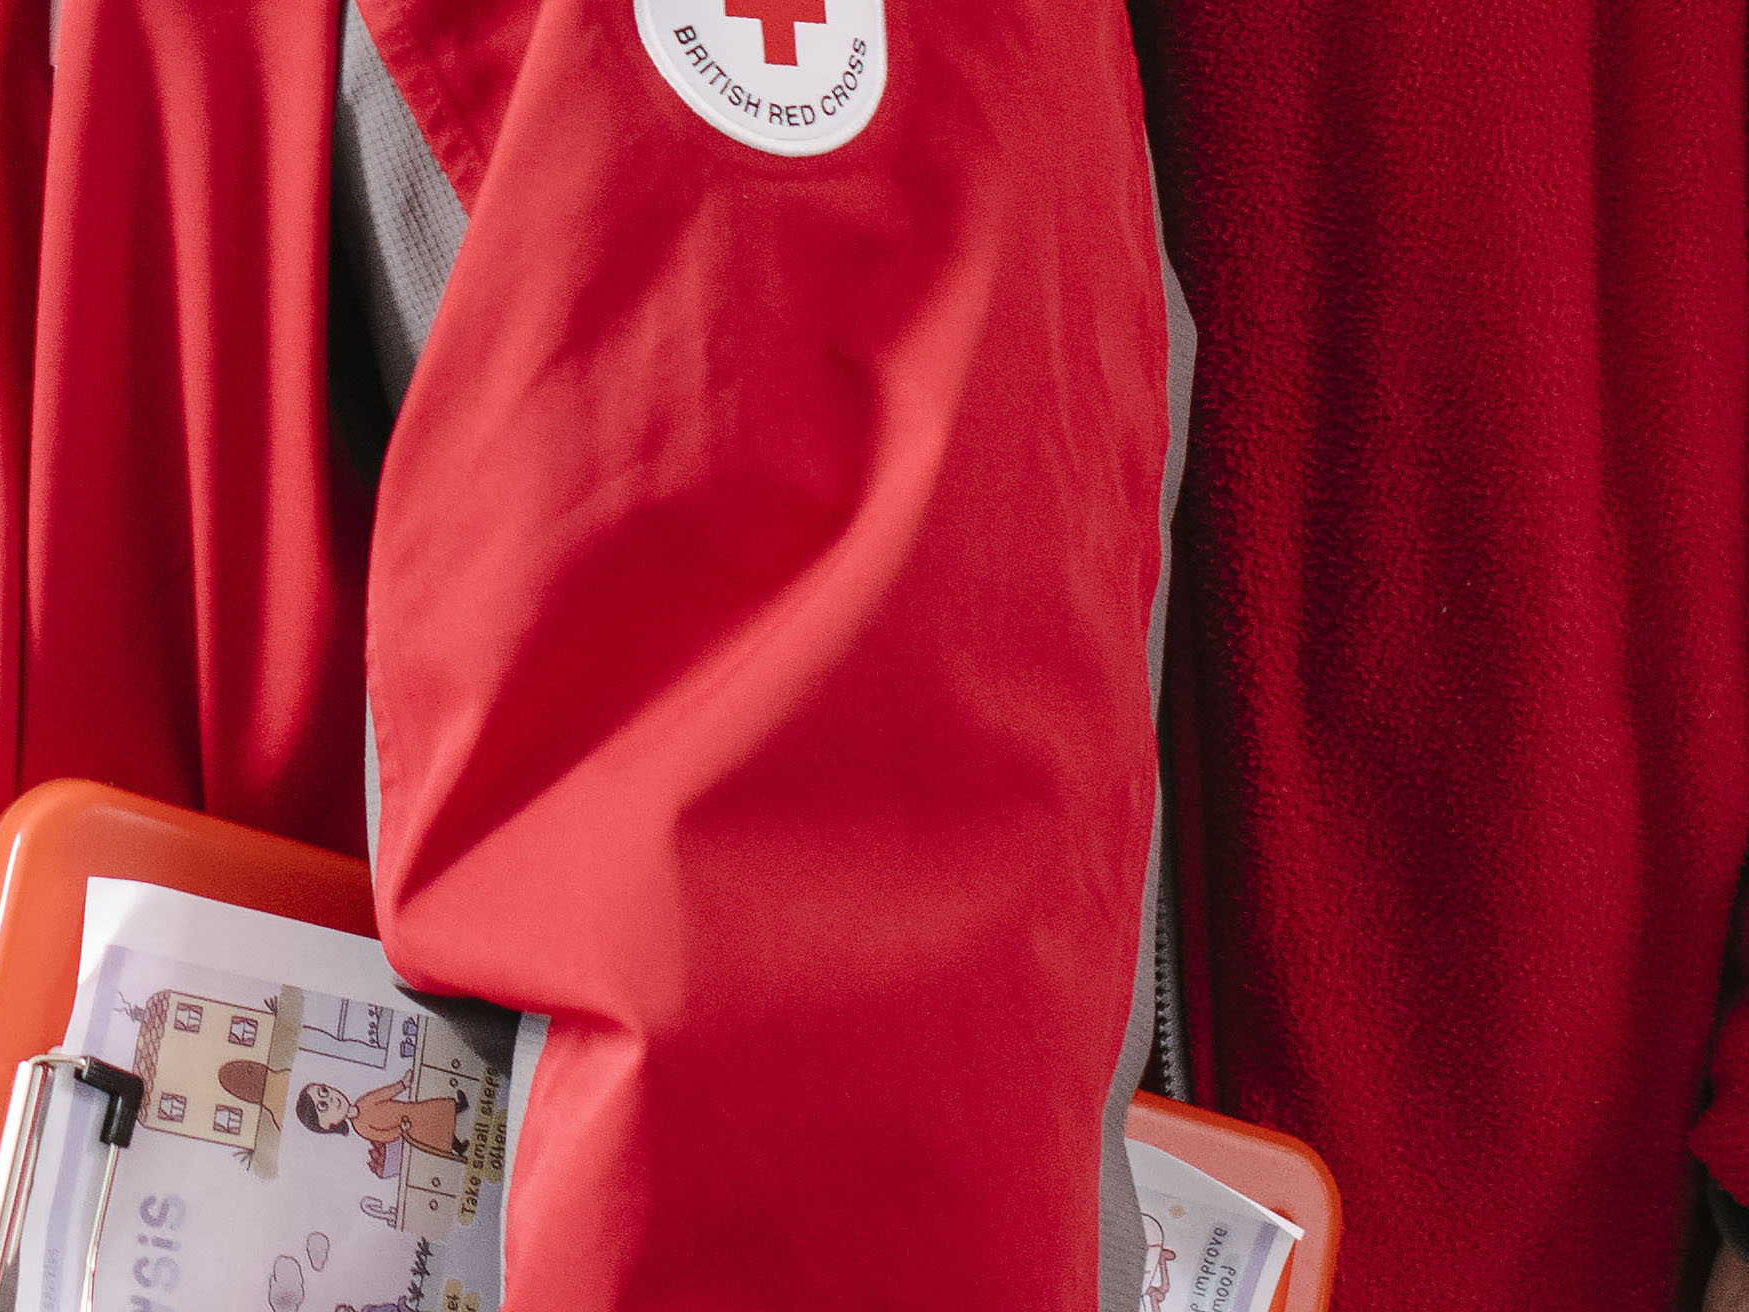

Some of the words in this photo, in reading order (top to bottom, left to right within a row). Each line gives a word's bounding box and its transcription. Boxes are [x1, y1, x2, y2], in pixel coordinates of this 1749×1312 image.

[673, 24, 760, 119] BRITISH
[766, 102, 816, 127] RED
[819, 37, 868, 119] CROSS
[461, 1176, 482, 1217] Take
[473, 1123, 490, 1169] small
[1193, 1227, 1228, 1298] improve
